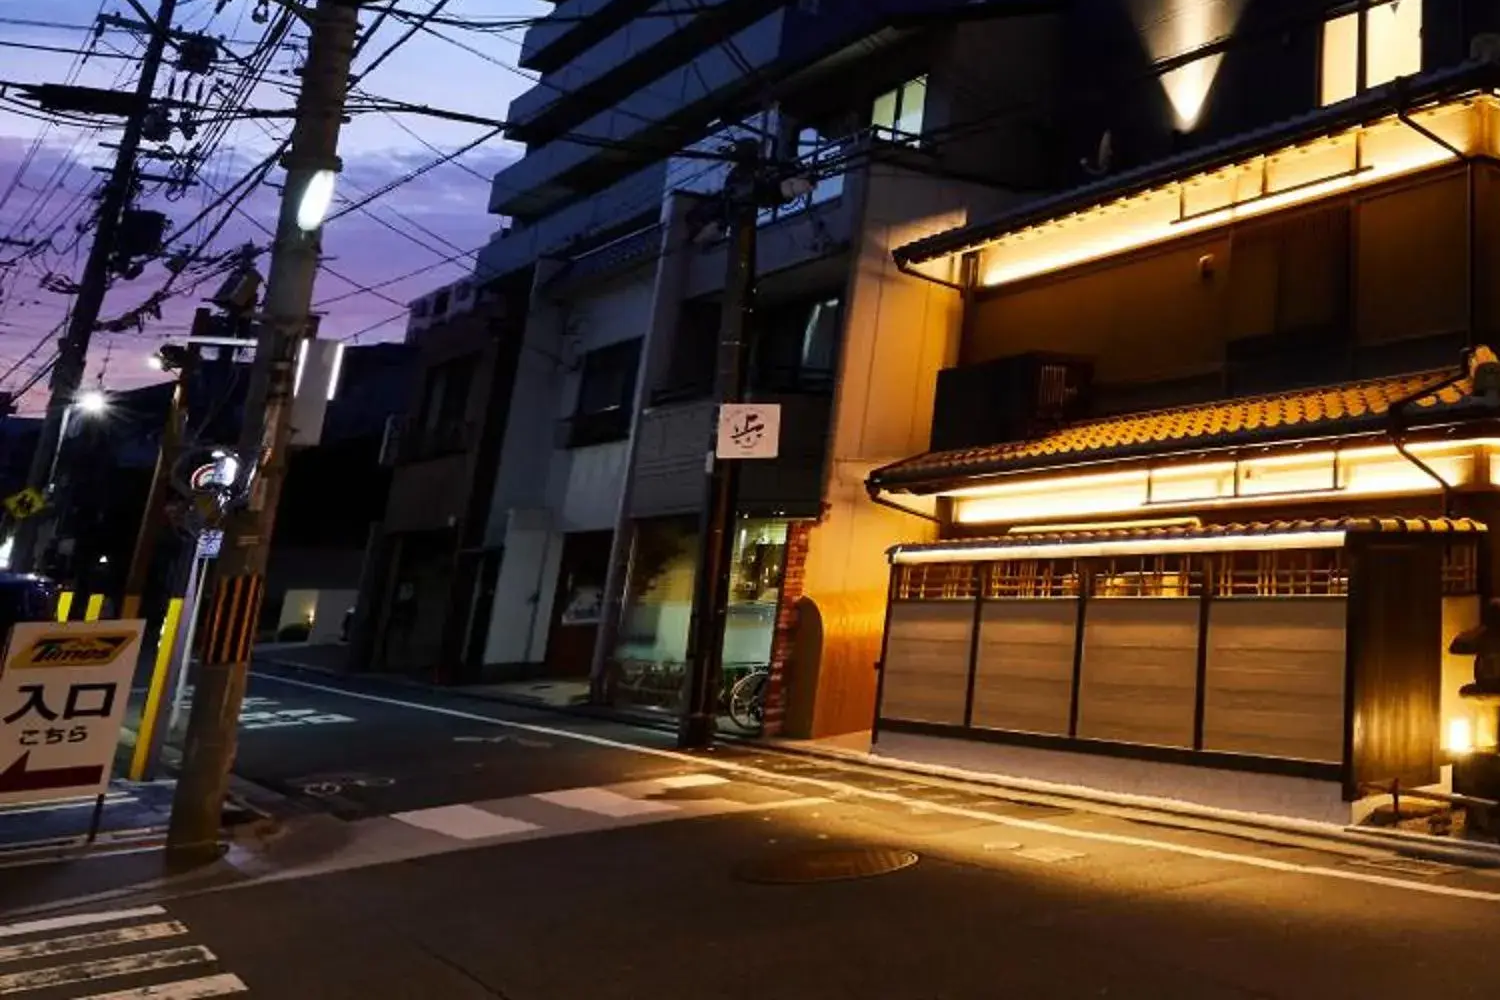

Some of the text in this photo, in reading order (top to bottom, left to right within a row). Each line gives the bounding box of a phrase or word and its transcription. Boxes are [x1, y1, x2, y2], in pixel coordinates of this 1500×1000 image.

[3, 682, 118, 725] 入口
[18, 725, 89, 746] こちら
